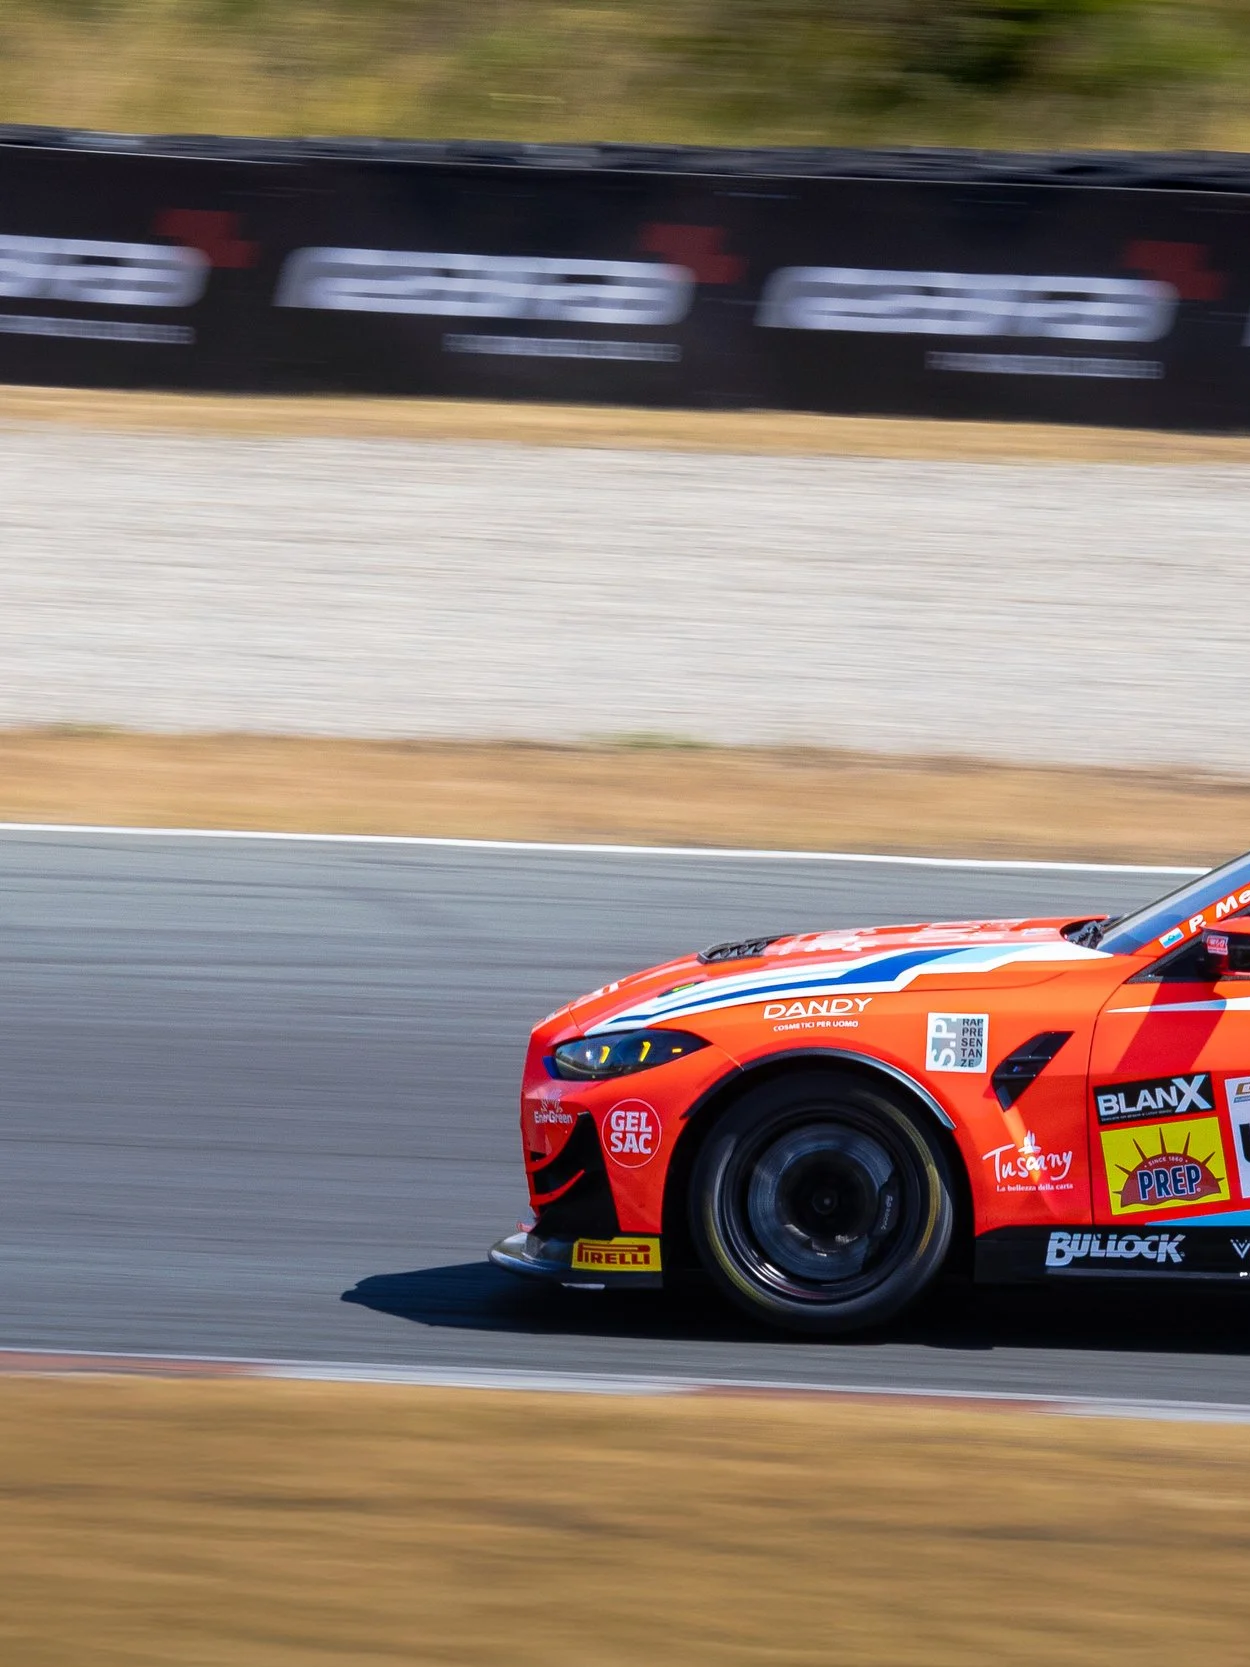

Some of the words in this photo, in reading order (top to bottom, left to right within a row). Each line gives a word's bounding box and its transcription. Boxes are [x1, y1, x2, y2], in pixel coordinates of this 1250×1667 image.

[1187, 915, 1206, 934] P.
[763, 997, 873, 1020] DANDY
[773, 1022, 815, 1032] COSMETICI
[832, 1020, 859, 1028] UOMO
[961, 1028, 983, 1037] PRE
[961, 1038, 983, 1047] SEN
[960, 1048, 983, 1058] TAN
[960, 1059, 974, 1067] ZE
[610, 1110, 652, 1132] GEL
[610, 1132, 652, 1155] SAC
[982, 1143, 1073, 1183] Tuscany
[1147, 1157, 1167, 1166] SINCE
[1037, 1183, 1054, 1191] della
[1137, 1163, 1202, 1201] PREP
[577, 1242, 651, 1265] PIRELLI
[1045, 1231, 1186, 1267] BULLOCK
